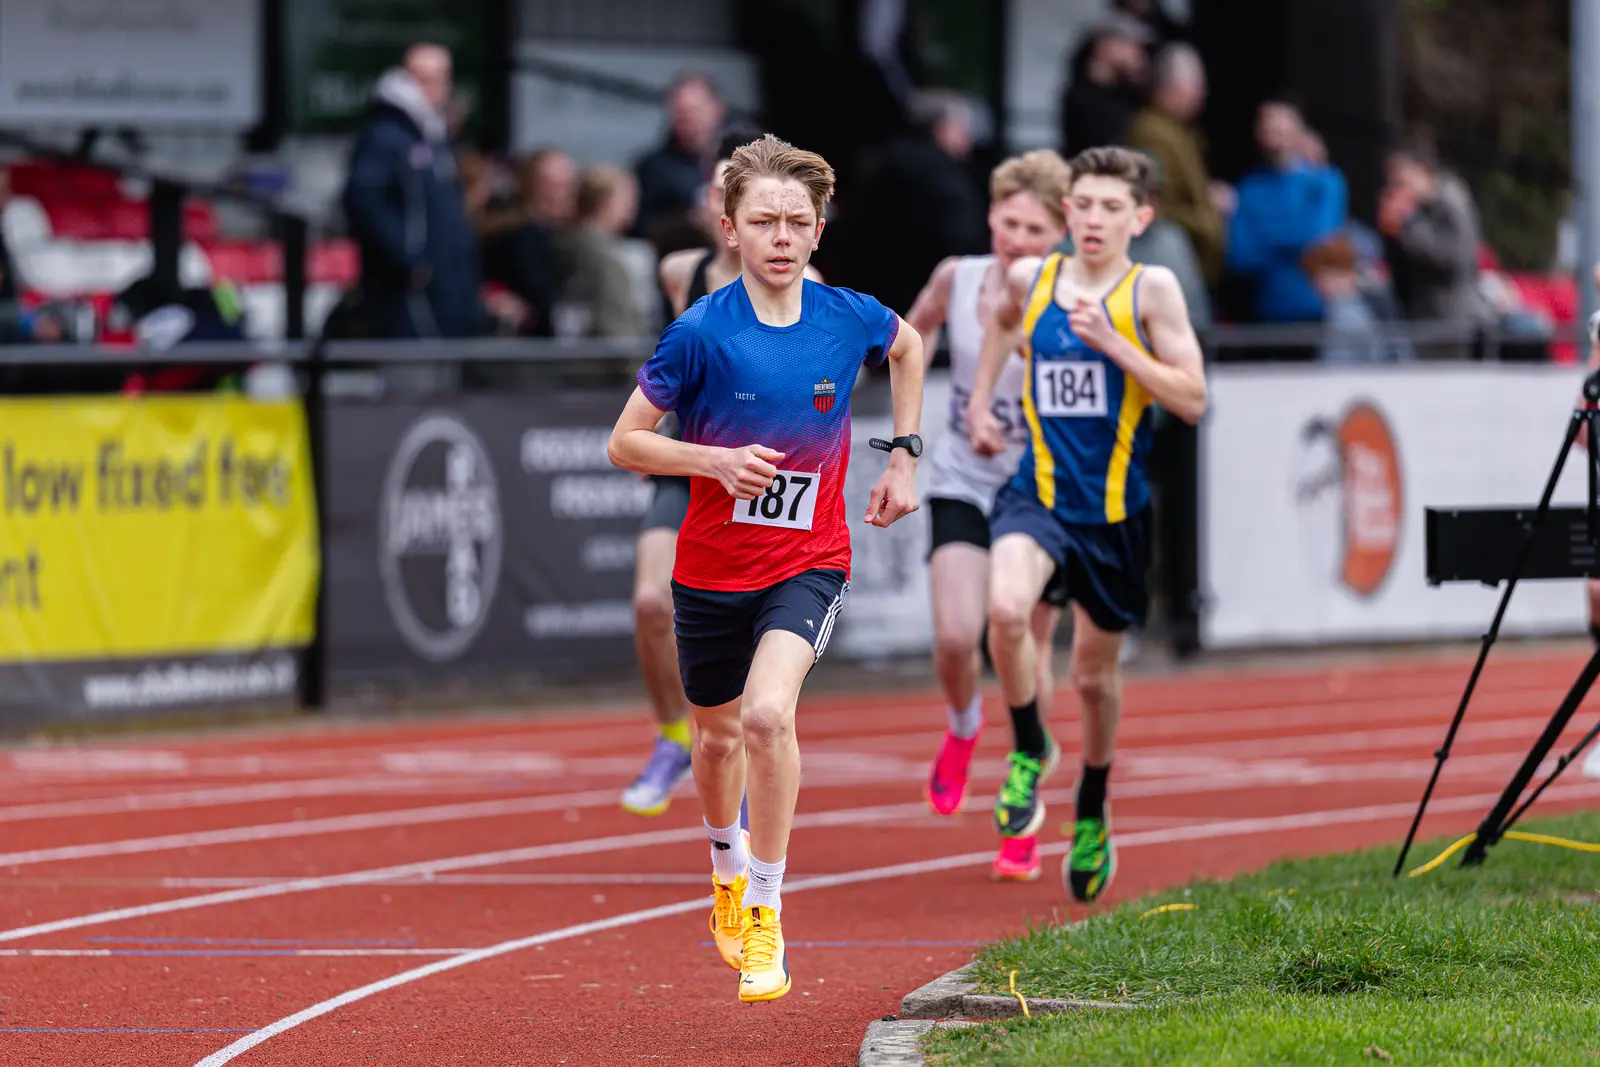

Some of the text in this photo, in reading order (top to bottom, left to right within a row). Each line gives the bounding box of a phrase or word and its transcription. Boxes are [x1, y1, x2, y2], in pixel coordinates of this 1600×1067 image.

[734, 392, 756, 401] TACTIC
[1043, 367, 1098, 408] 184
[5, 441, 84, 515] low
